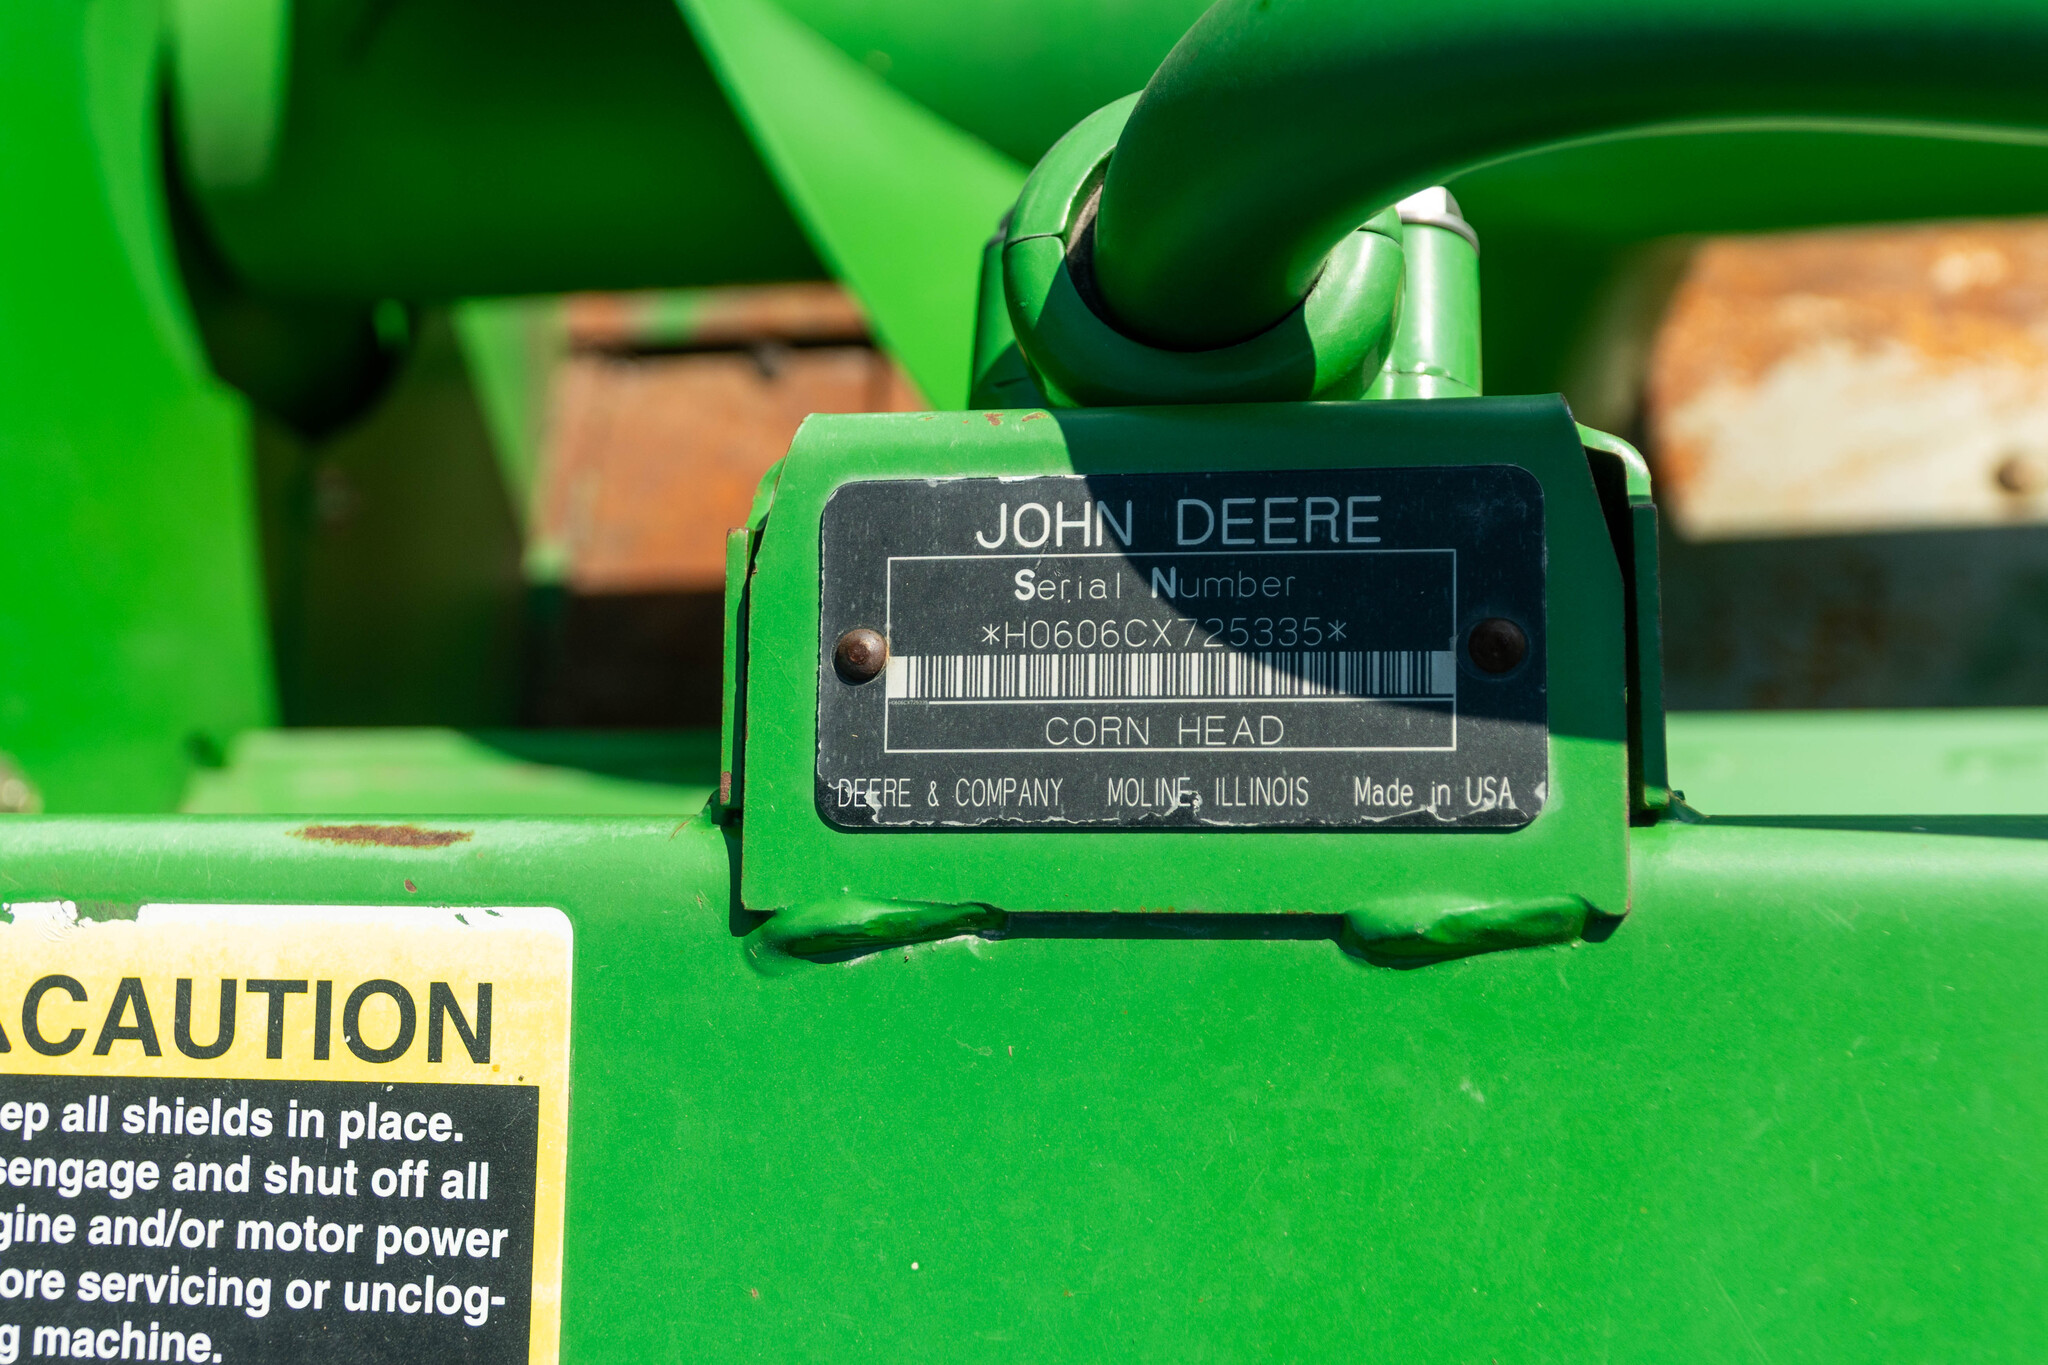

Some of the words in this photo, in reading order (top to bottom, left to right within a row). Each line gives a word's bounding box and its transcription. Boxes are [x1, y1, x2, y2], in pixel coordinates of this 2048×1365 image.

[974, 498, 1136, 550] JOHN
[1175, 493, 1384, 547] DEERE
[1012, 567, 1122, 604] Serial
[1150, 564, 1298, 600] Number
[1044, 714, 1154, 748] CORN
[1176, 712, 1288, 747] HEAD
[836, 777, 912, 808] DEERE
[926, 780, 941, 807] &
[954, 777, 1064, 808] COMPANY
[1215, 776, 1310, 807] ILLINOIS
[1353, 775, 1414, 807] Made
[1430, 780, 1450, 808] in
[1465, 775, 1514, 808] USA
[22, 975, 492, 1064] CAUTION
[62, 1095, 108, 1132] all
[122, 1097, 272, 1137] shields
[288, 1100, 324, 1137] in
[340, 1102, 463, 1149] place.
[173, 1155, 250, 1192] and
[264, 1156, 358, 1195] shut
[372, 1159, 428, 1197] off
[441, 1162, 488, 1199] all
[88, 1209, 224, 1248] and/or
[237, 1216, 363, 1252] motor
[377, 1225, 508, 1264] power
[77, 1266, 271, 1318] servicing
[286, 1280, 330, 1309] or
[345, 1275, 505, 1326] unclog-
[33, 1321, 221, 1363] machine.
